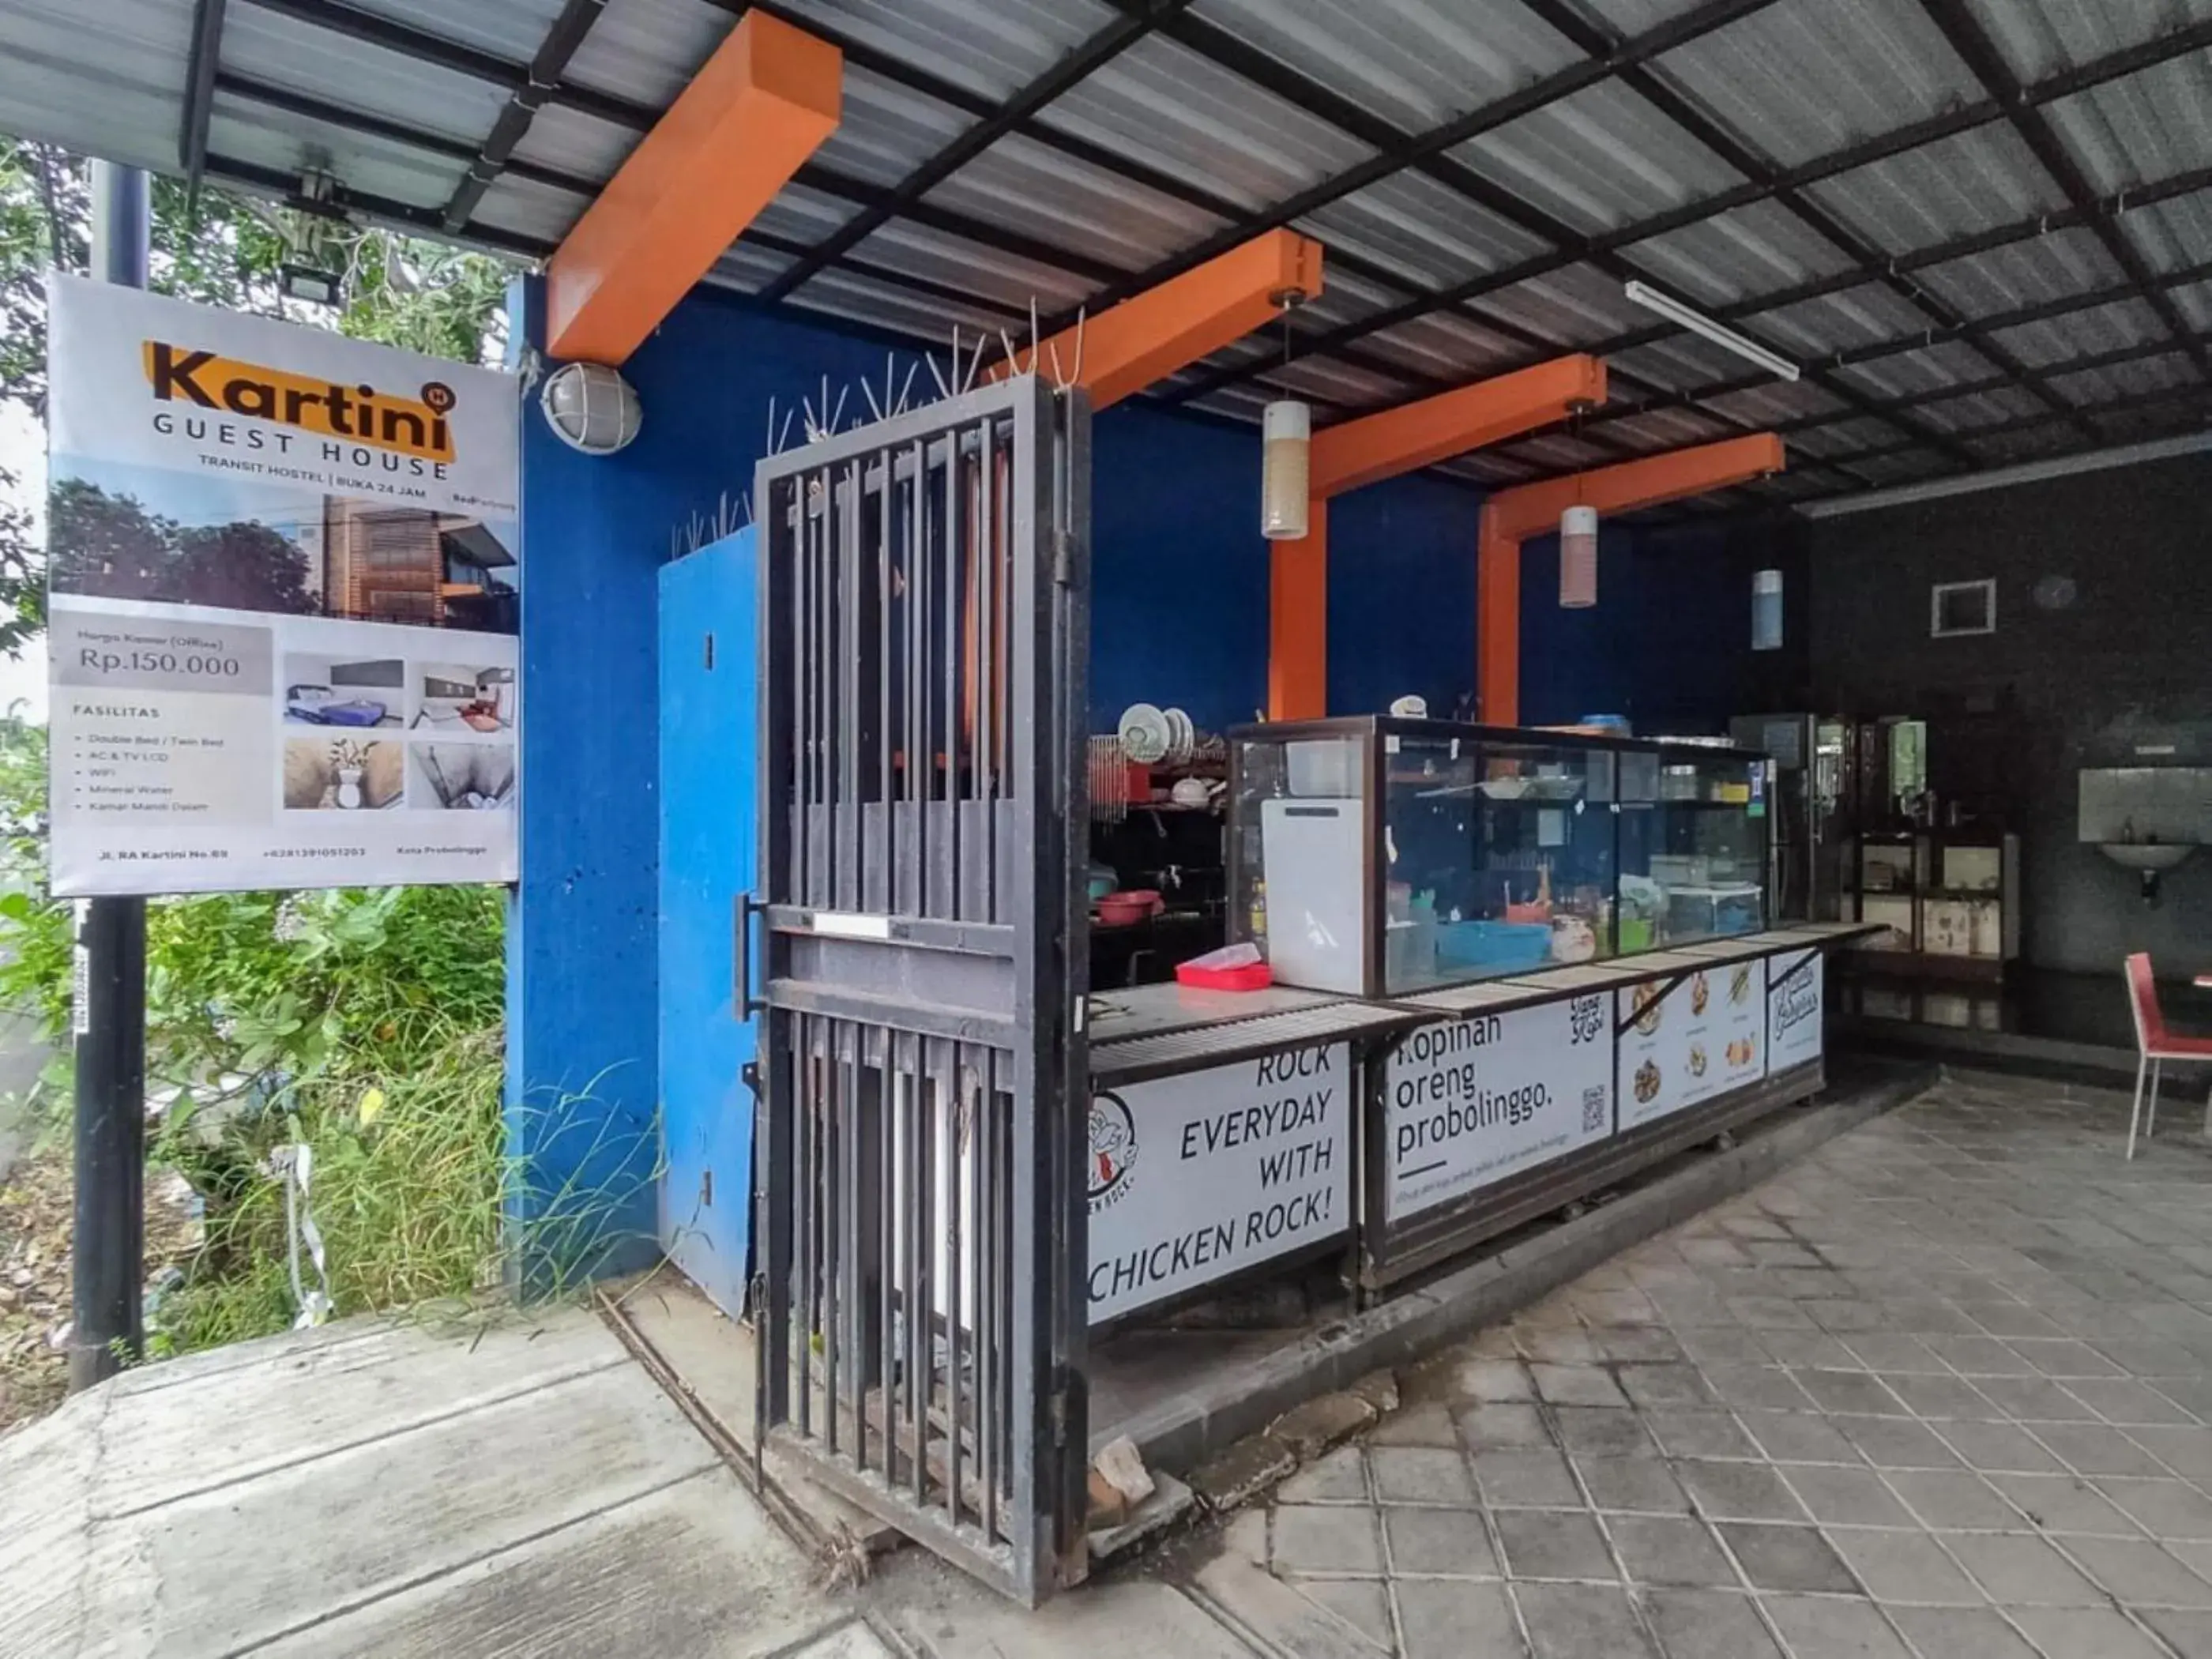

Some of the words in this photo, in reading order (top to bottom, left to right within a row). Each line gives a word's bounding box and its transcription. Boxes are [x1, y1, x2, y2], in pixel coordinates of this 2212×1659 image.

[152, 342, 447, 451] Kartini
[153, 412, 293, 453] GUEST
[322, 442, 449, 481] HOUSE
[198, 454, 264, 474] TRANSIT
[268, 465, 325, 483] HOSTEL
[336, 476, 374, 491] BUKA
[378, 480, 394, 495] 24
[398, 484, 426, 498] JAM
[81, 648, 239, 676] Rp.150.000
[73, 705, 160, 718] FASILITAS
[88, 752, 107, 761] AC
[142, 753, 168, 762] LCD
[141, 850, 186, 860] Kartini
[1257, 1044, 1332, 1088] ROCK
[1396, 1062, 1476, 1110] oreng
[1180, 1088, 1334, 1161] EVERYDAY
[1397, 1082, 1552, 1165] probolinggo.
[1259, 1137, 1334, 1190] WITH
[1087, 1219, 1236, 1304] CHICKEN
[1245, 1186, 1334, 1250] ROCK!
